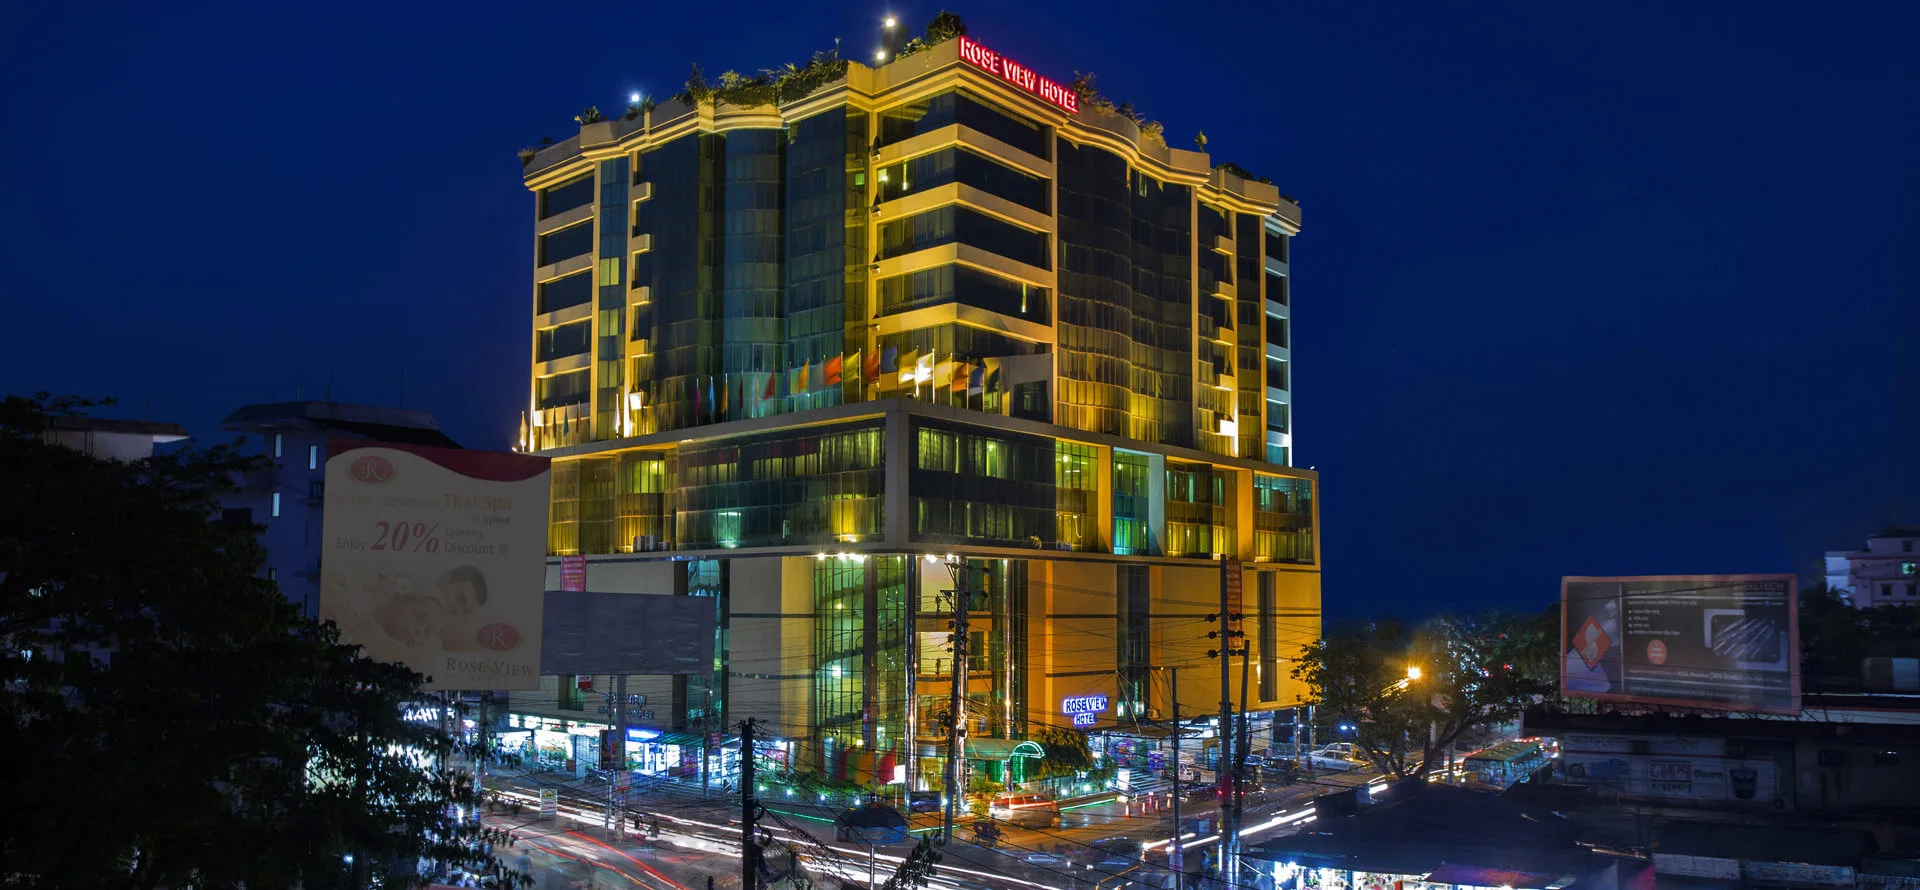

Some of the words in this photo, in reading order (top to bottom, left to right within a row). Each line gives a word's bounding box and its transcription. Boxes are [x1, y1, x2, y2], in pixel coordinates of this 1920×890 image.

[960, 36, 1000, 74] ROSE
[1002, 57, 1036, 92] VIEW
[1038, 76, 1078, 114] HOTEL
[444, 493, 477, 510] Thai
[482, 494, 511, 512] Spa
[482, 515, 511, 526] Sylhet
[336, 536, 367, 552] Enjoy
[370, 520, 440, 553] 20%
[445, 541, 495, 555] Discount
[445, 528, 483, 539] Opening
[446, 657, 486, 673] ROSE
[493, 661, 534, 677] VIEW
[1063, 698, 1086, 713] ROSE
[1086, 697, 1107, 711] VIEW
[1074, 713, 1096, 725] HOTEL
